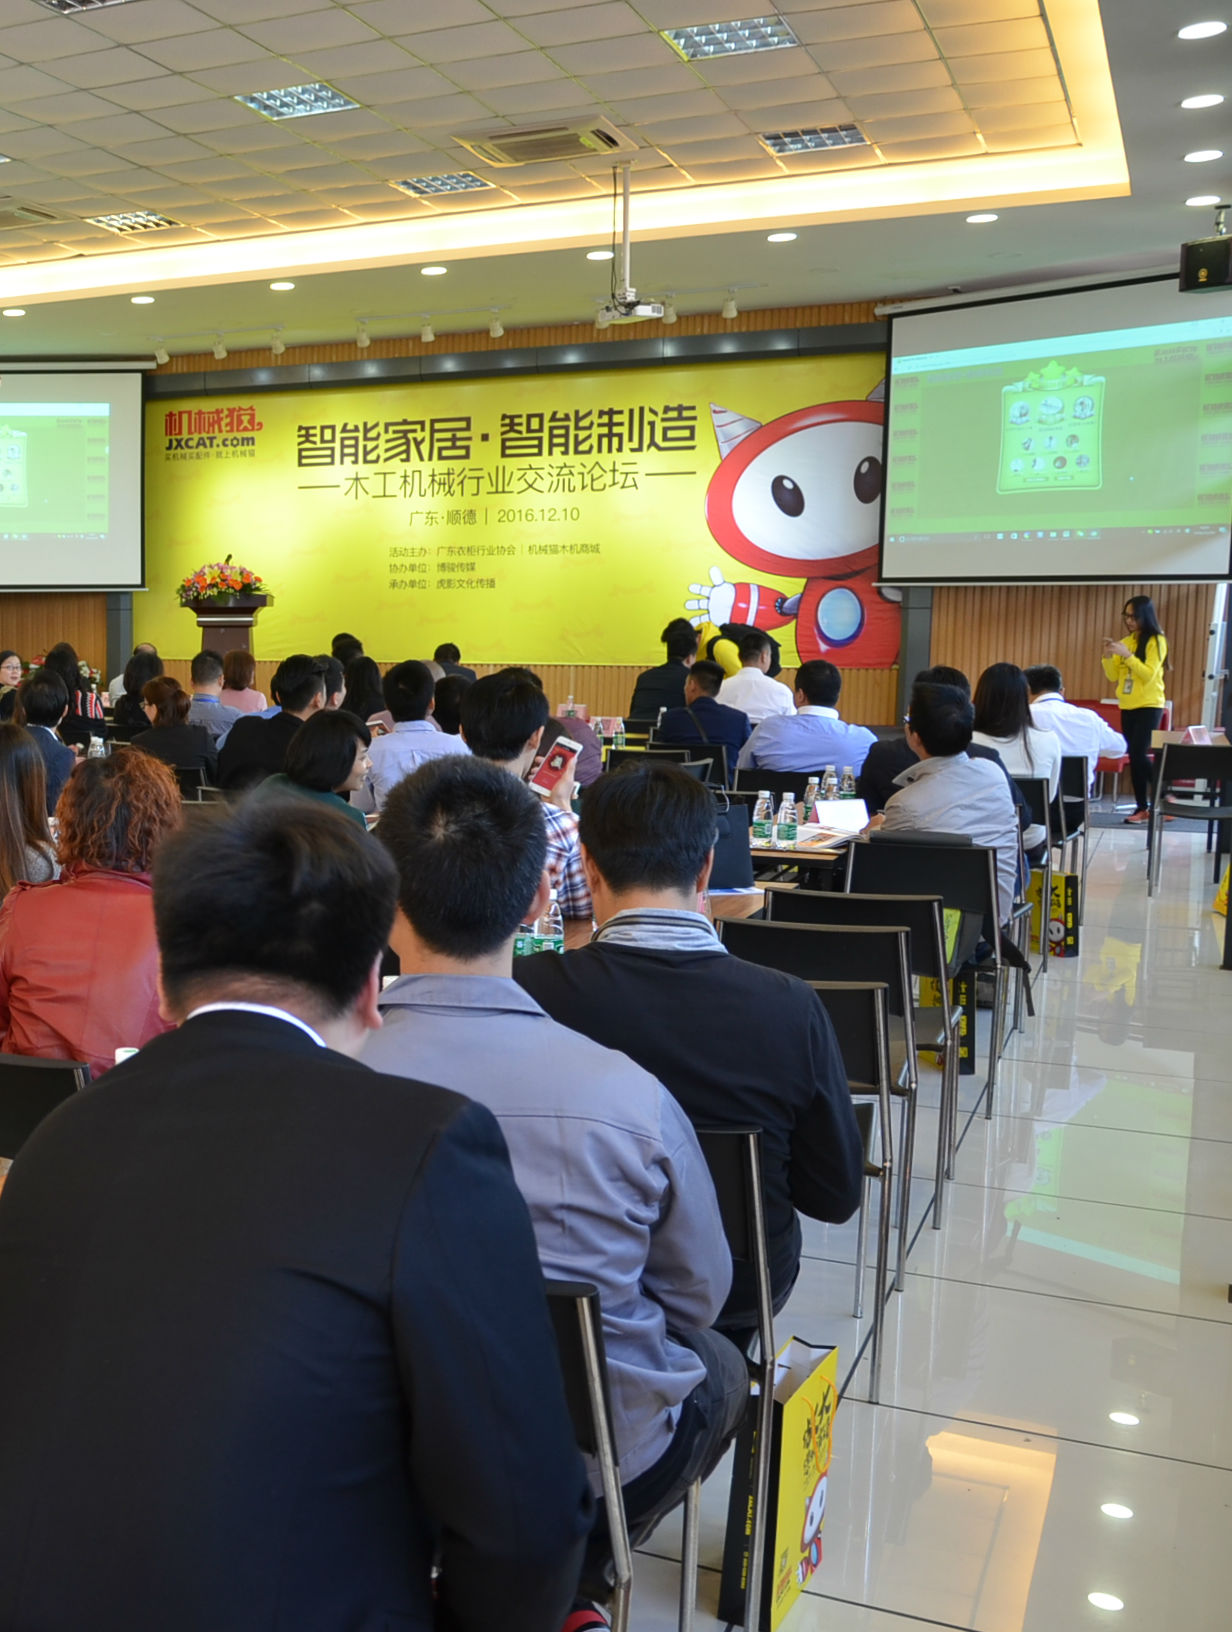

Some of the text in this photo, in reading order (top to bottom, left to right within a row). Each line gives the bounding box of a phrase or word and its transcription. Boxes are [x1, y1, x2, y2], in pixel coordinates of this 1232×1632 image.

[165, 405, 263, 437] 机械猫
[297, 404, 698, 468] 智能家居·智能制造
[166, 436, 256, 450] JXCAT.com
[344, 461, 639, 501] 木工机械行业交流论坛
[497, 507, 580, 523] 2016.12.10
